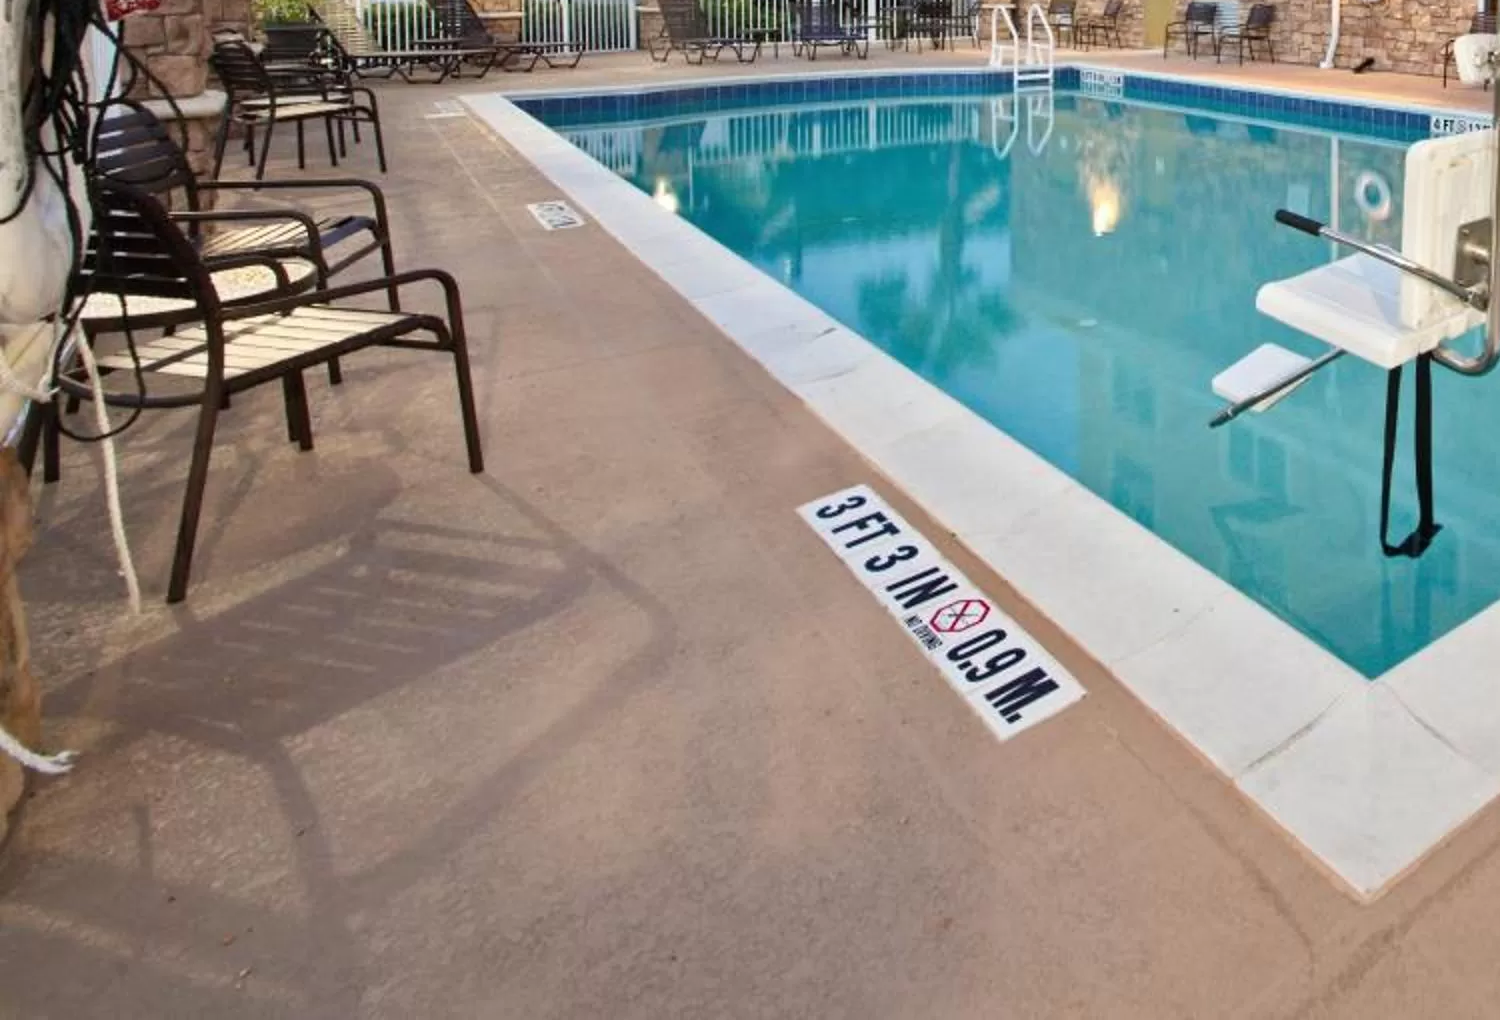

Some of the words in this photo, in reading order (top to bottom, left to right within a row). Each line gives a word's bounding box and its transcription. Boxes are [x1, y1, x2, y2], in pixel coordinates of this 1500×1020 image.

[1443, 119, 1455, 132] FT
[816, 495, 867, 519] 3
[831, 511, 901, 549] FT
[864, 545, 919, 572] 3
[885, 567, 959, 609] IN
[946, 629, 1027, 683] 0.9
[984, 667, 1060, 724] M.
